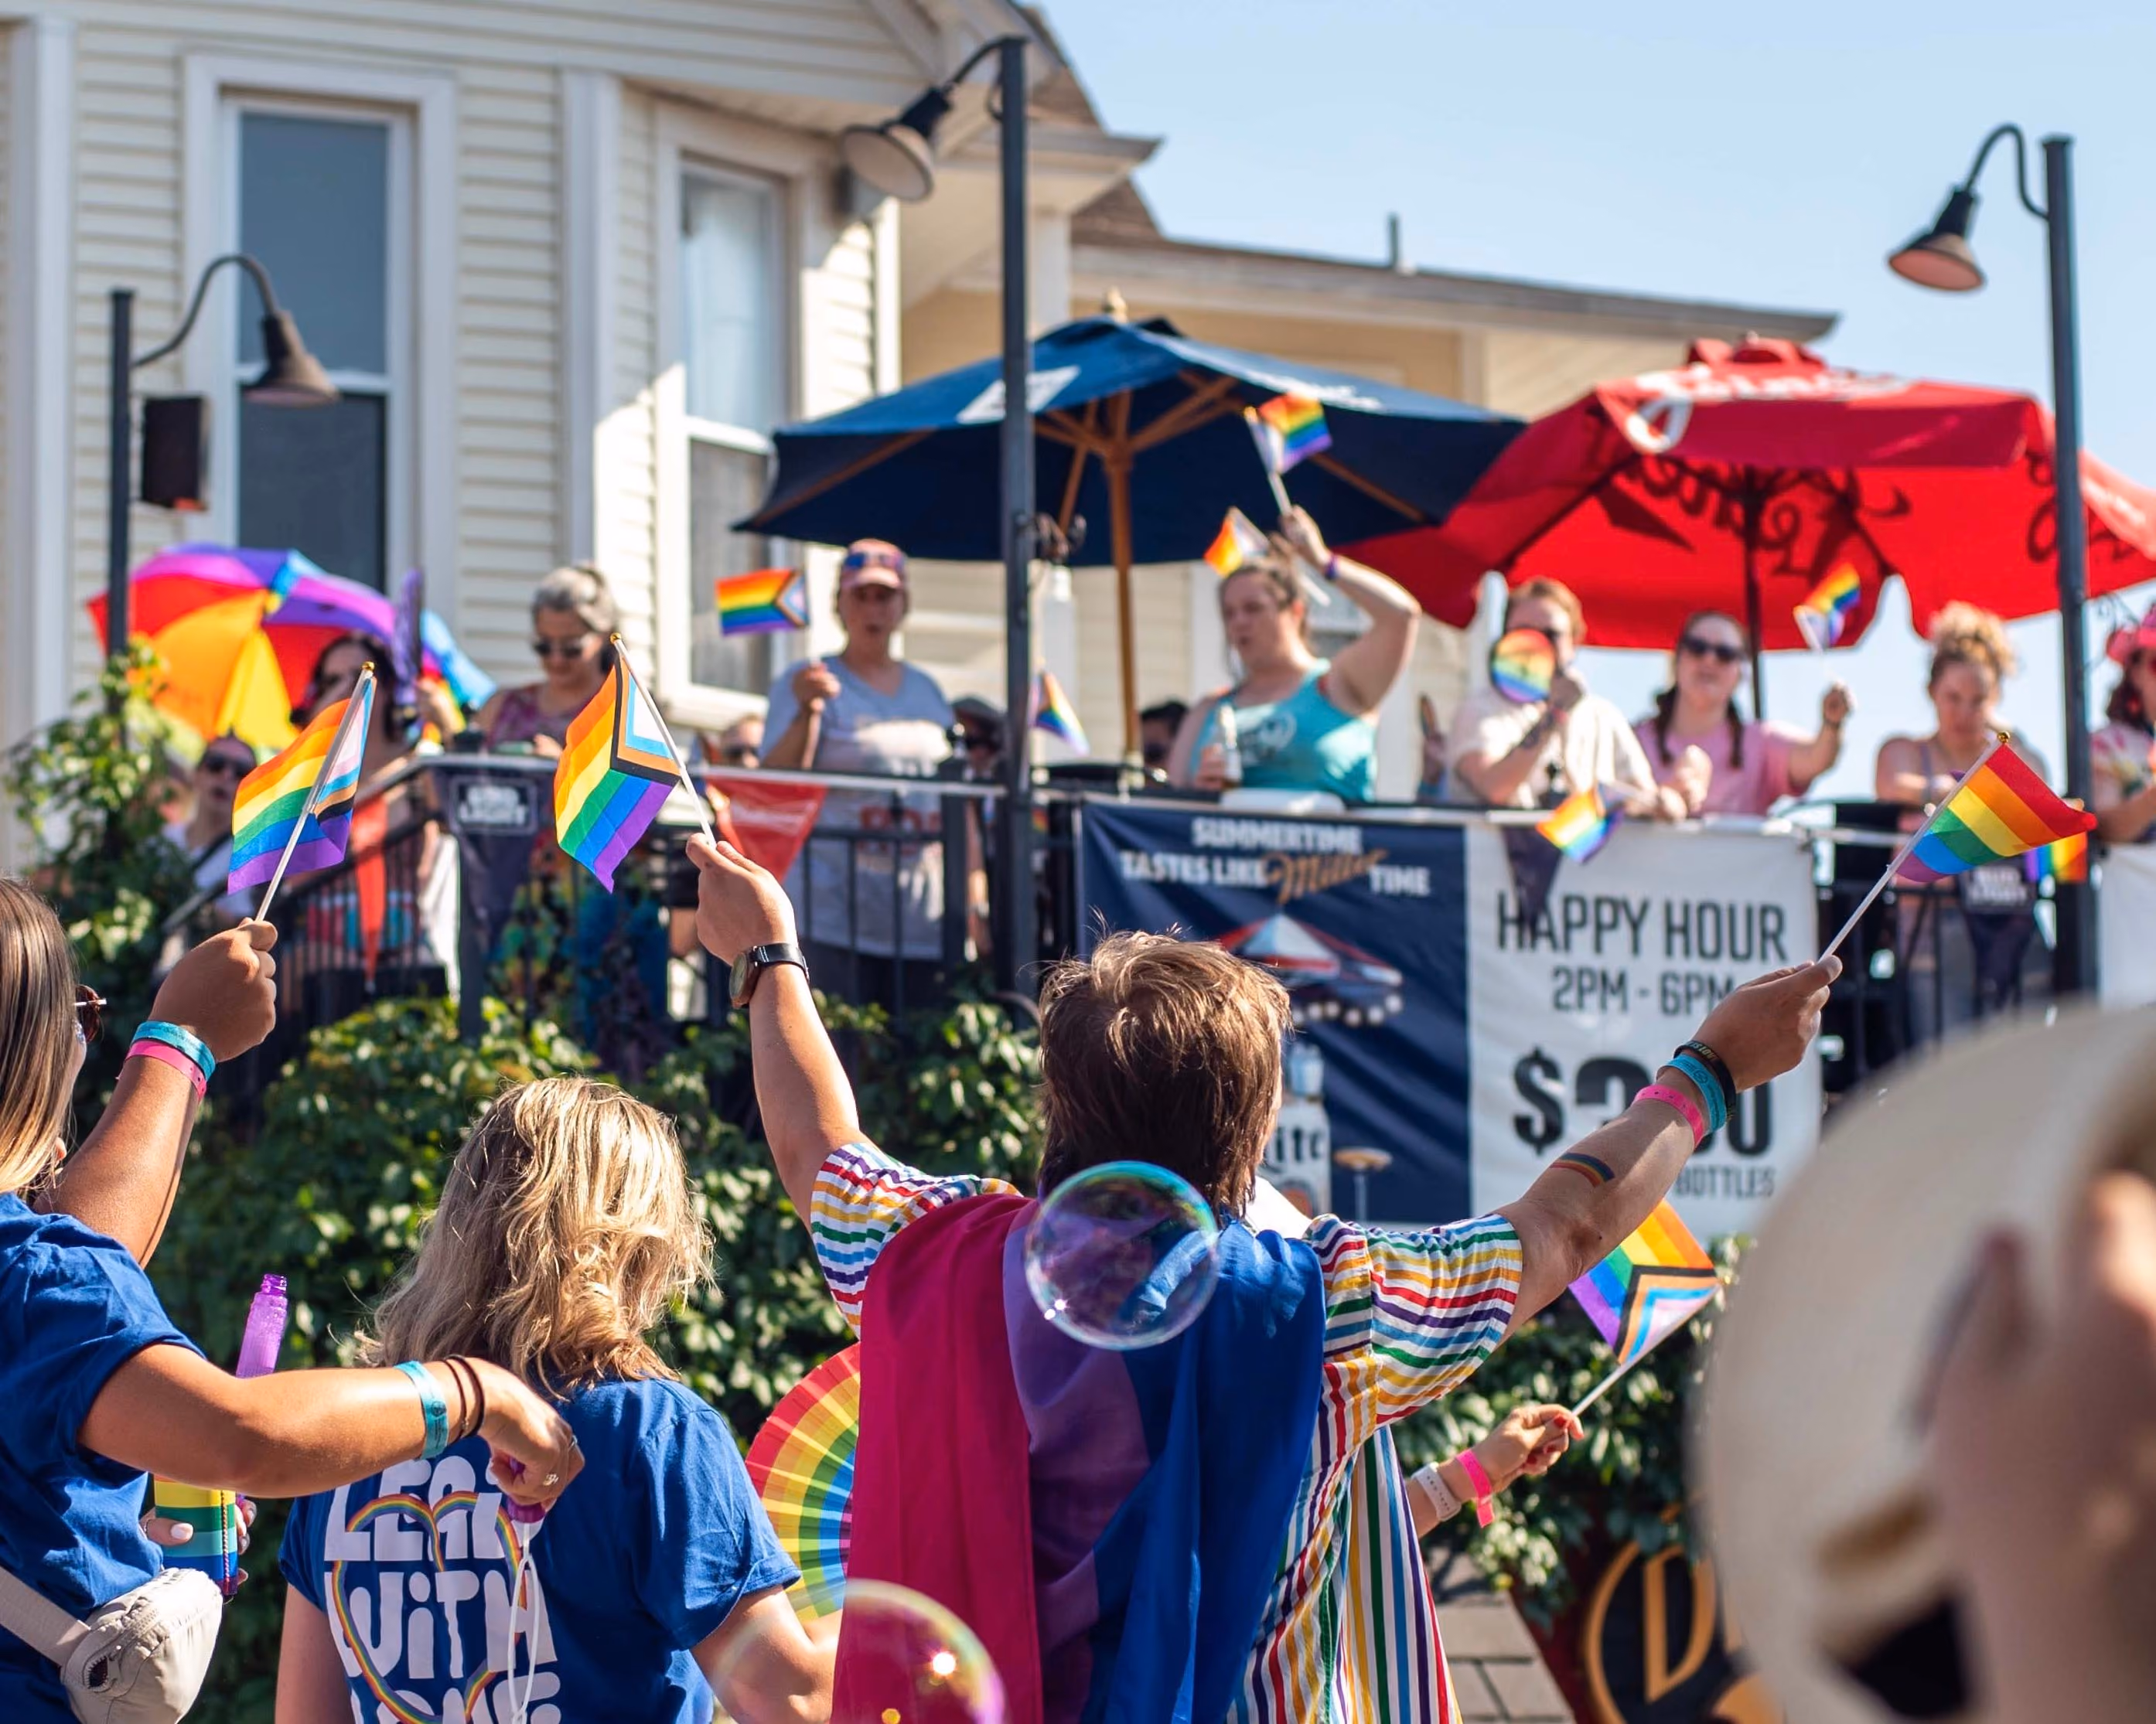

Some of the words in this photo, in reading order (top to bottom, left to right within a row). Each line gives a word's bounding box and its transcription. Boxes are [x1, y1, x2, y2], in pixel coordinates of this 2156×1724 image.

[1191, 816, 1363, 854] SUMMERTIME
[1119, 850, 1209, 884] TASTES
[1213, 856, 1267, 888] LIKE
[1262, 848, 1390, 907] Miller
[1369, 864, 1431, 897] TIME
[1497, 892, 1649, 959] HAPPY
[1664, 898, 1788, 963] HOUR
[1551, 965, 1629, 1015] 2PM
[1262, 1126, 1323, 1174] ite
